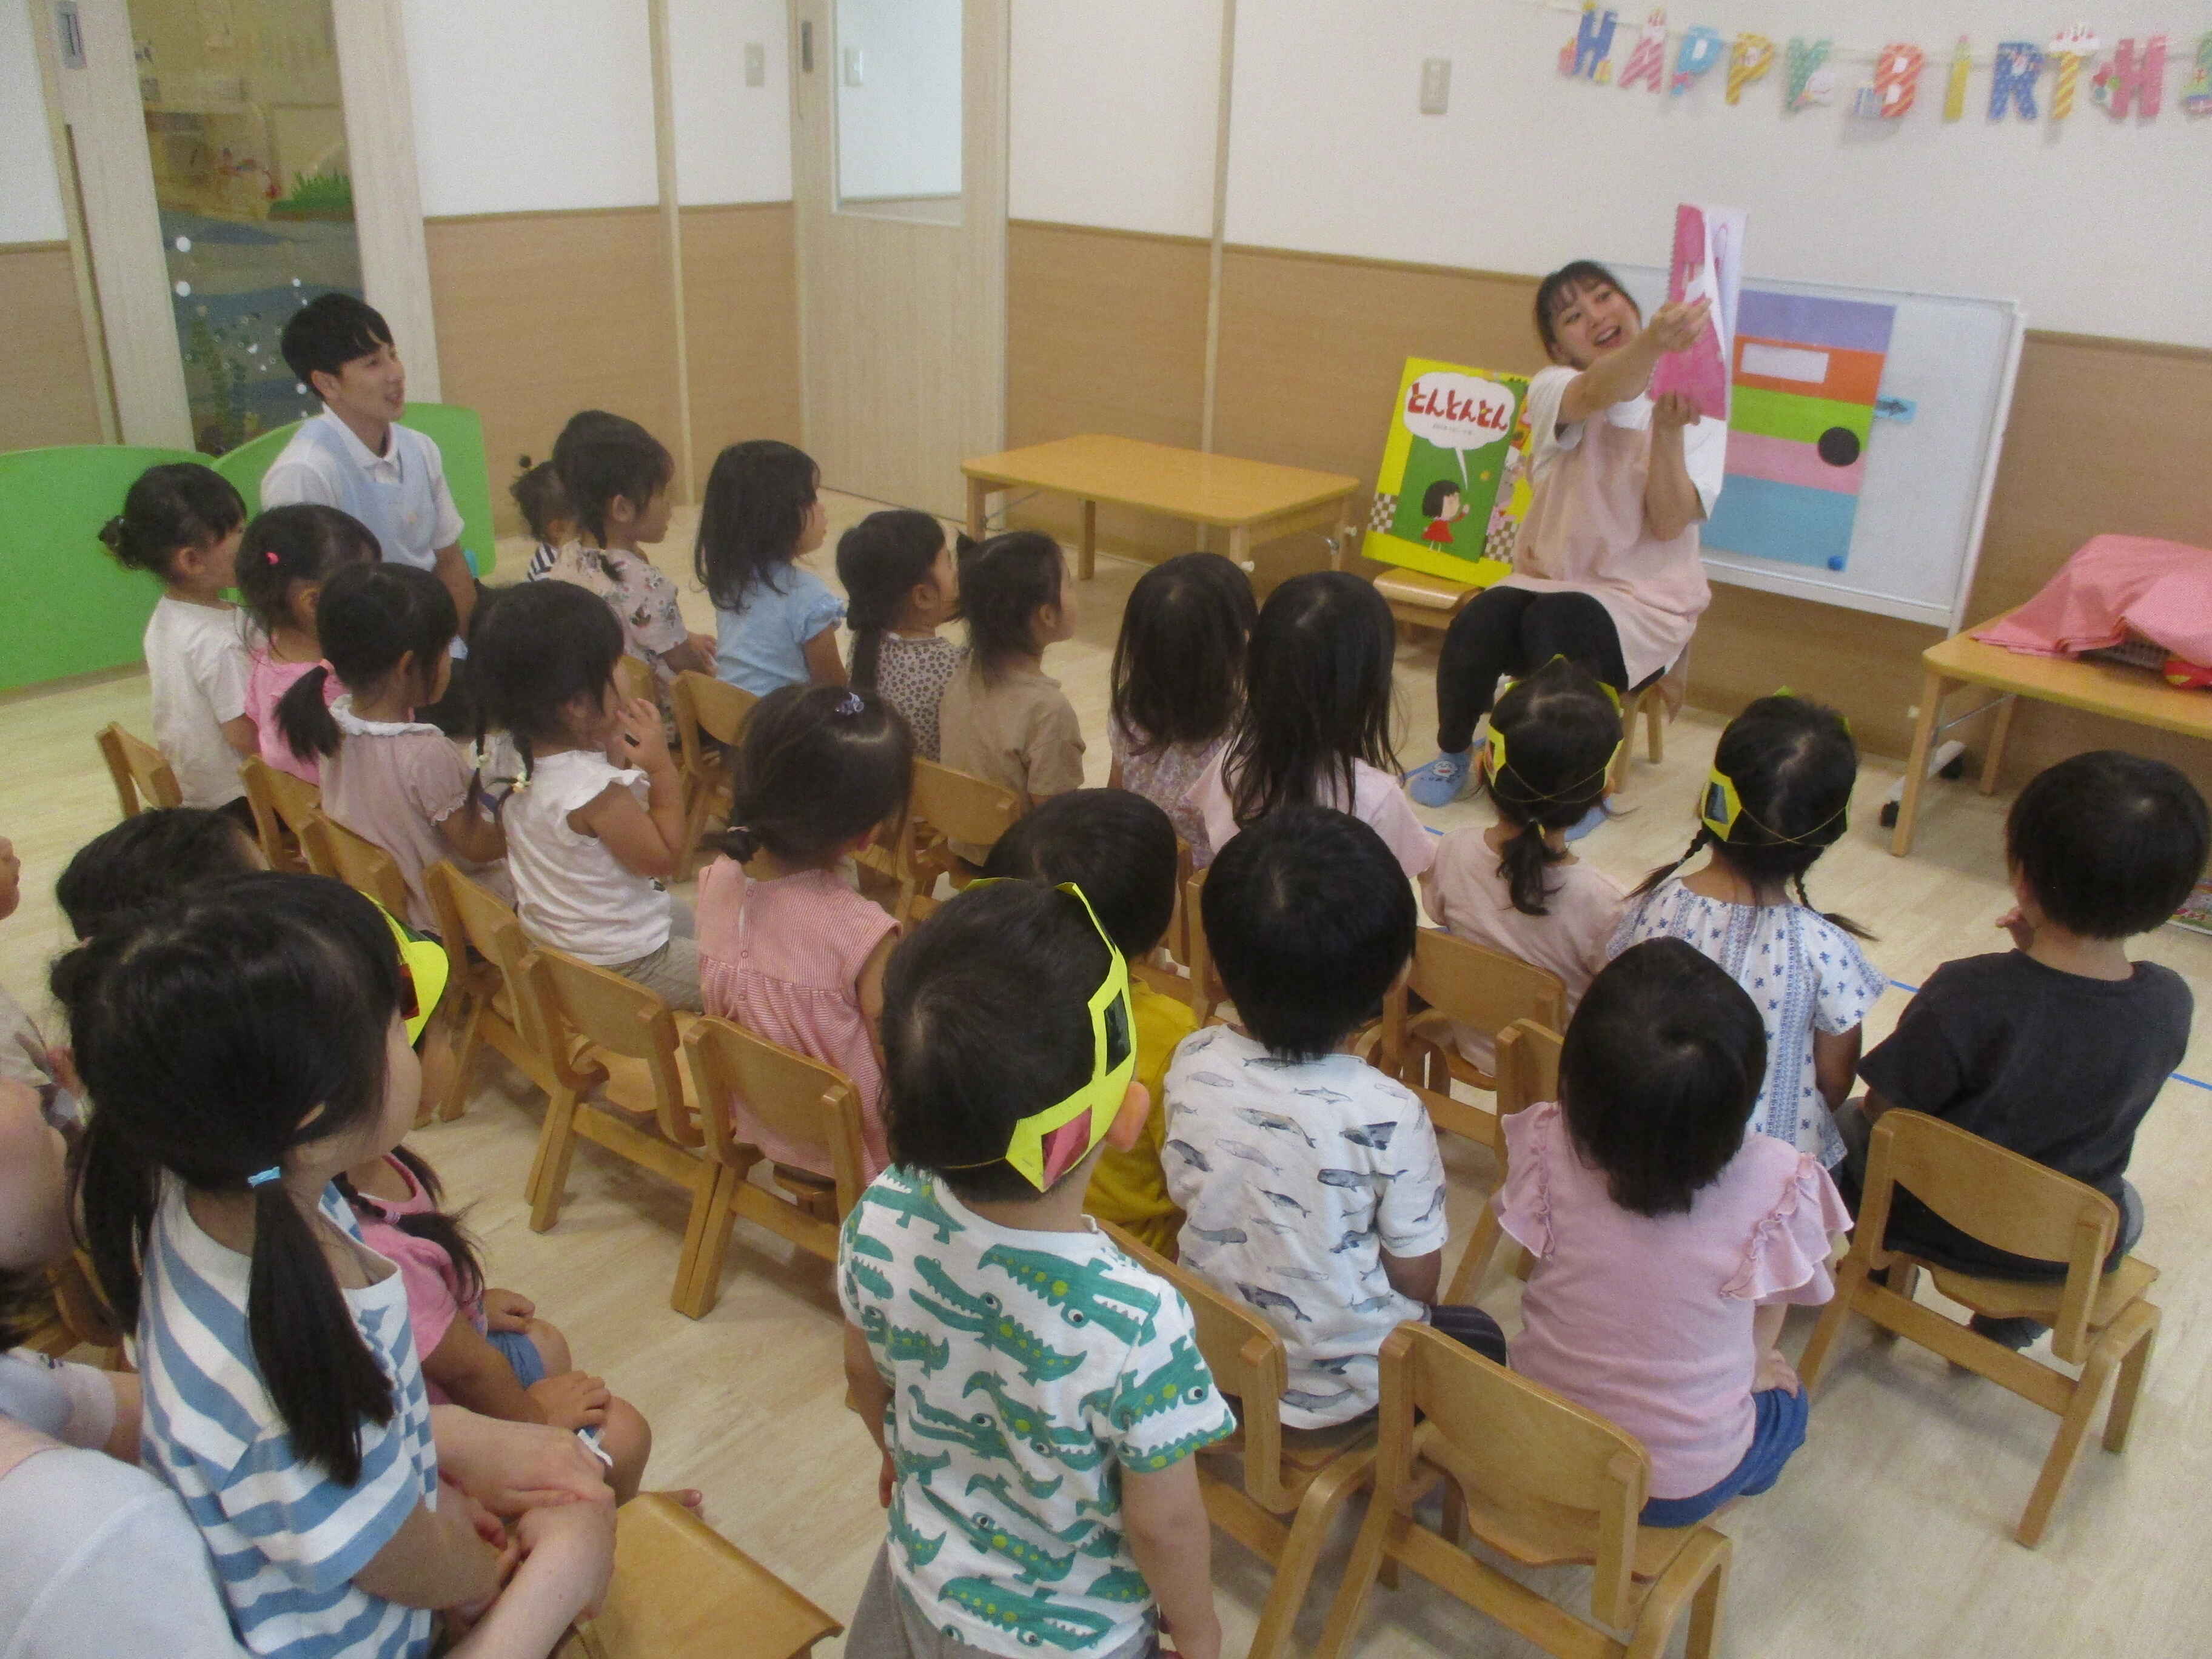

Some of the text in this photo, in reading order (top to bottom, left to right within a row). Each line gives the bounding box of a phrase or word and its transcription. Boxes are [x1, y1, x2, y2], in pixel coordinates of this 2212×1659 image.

[1567, 7, 1834, 113] HAPPY
[1407, 382, 1509, 432] とんとんとん
